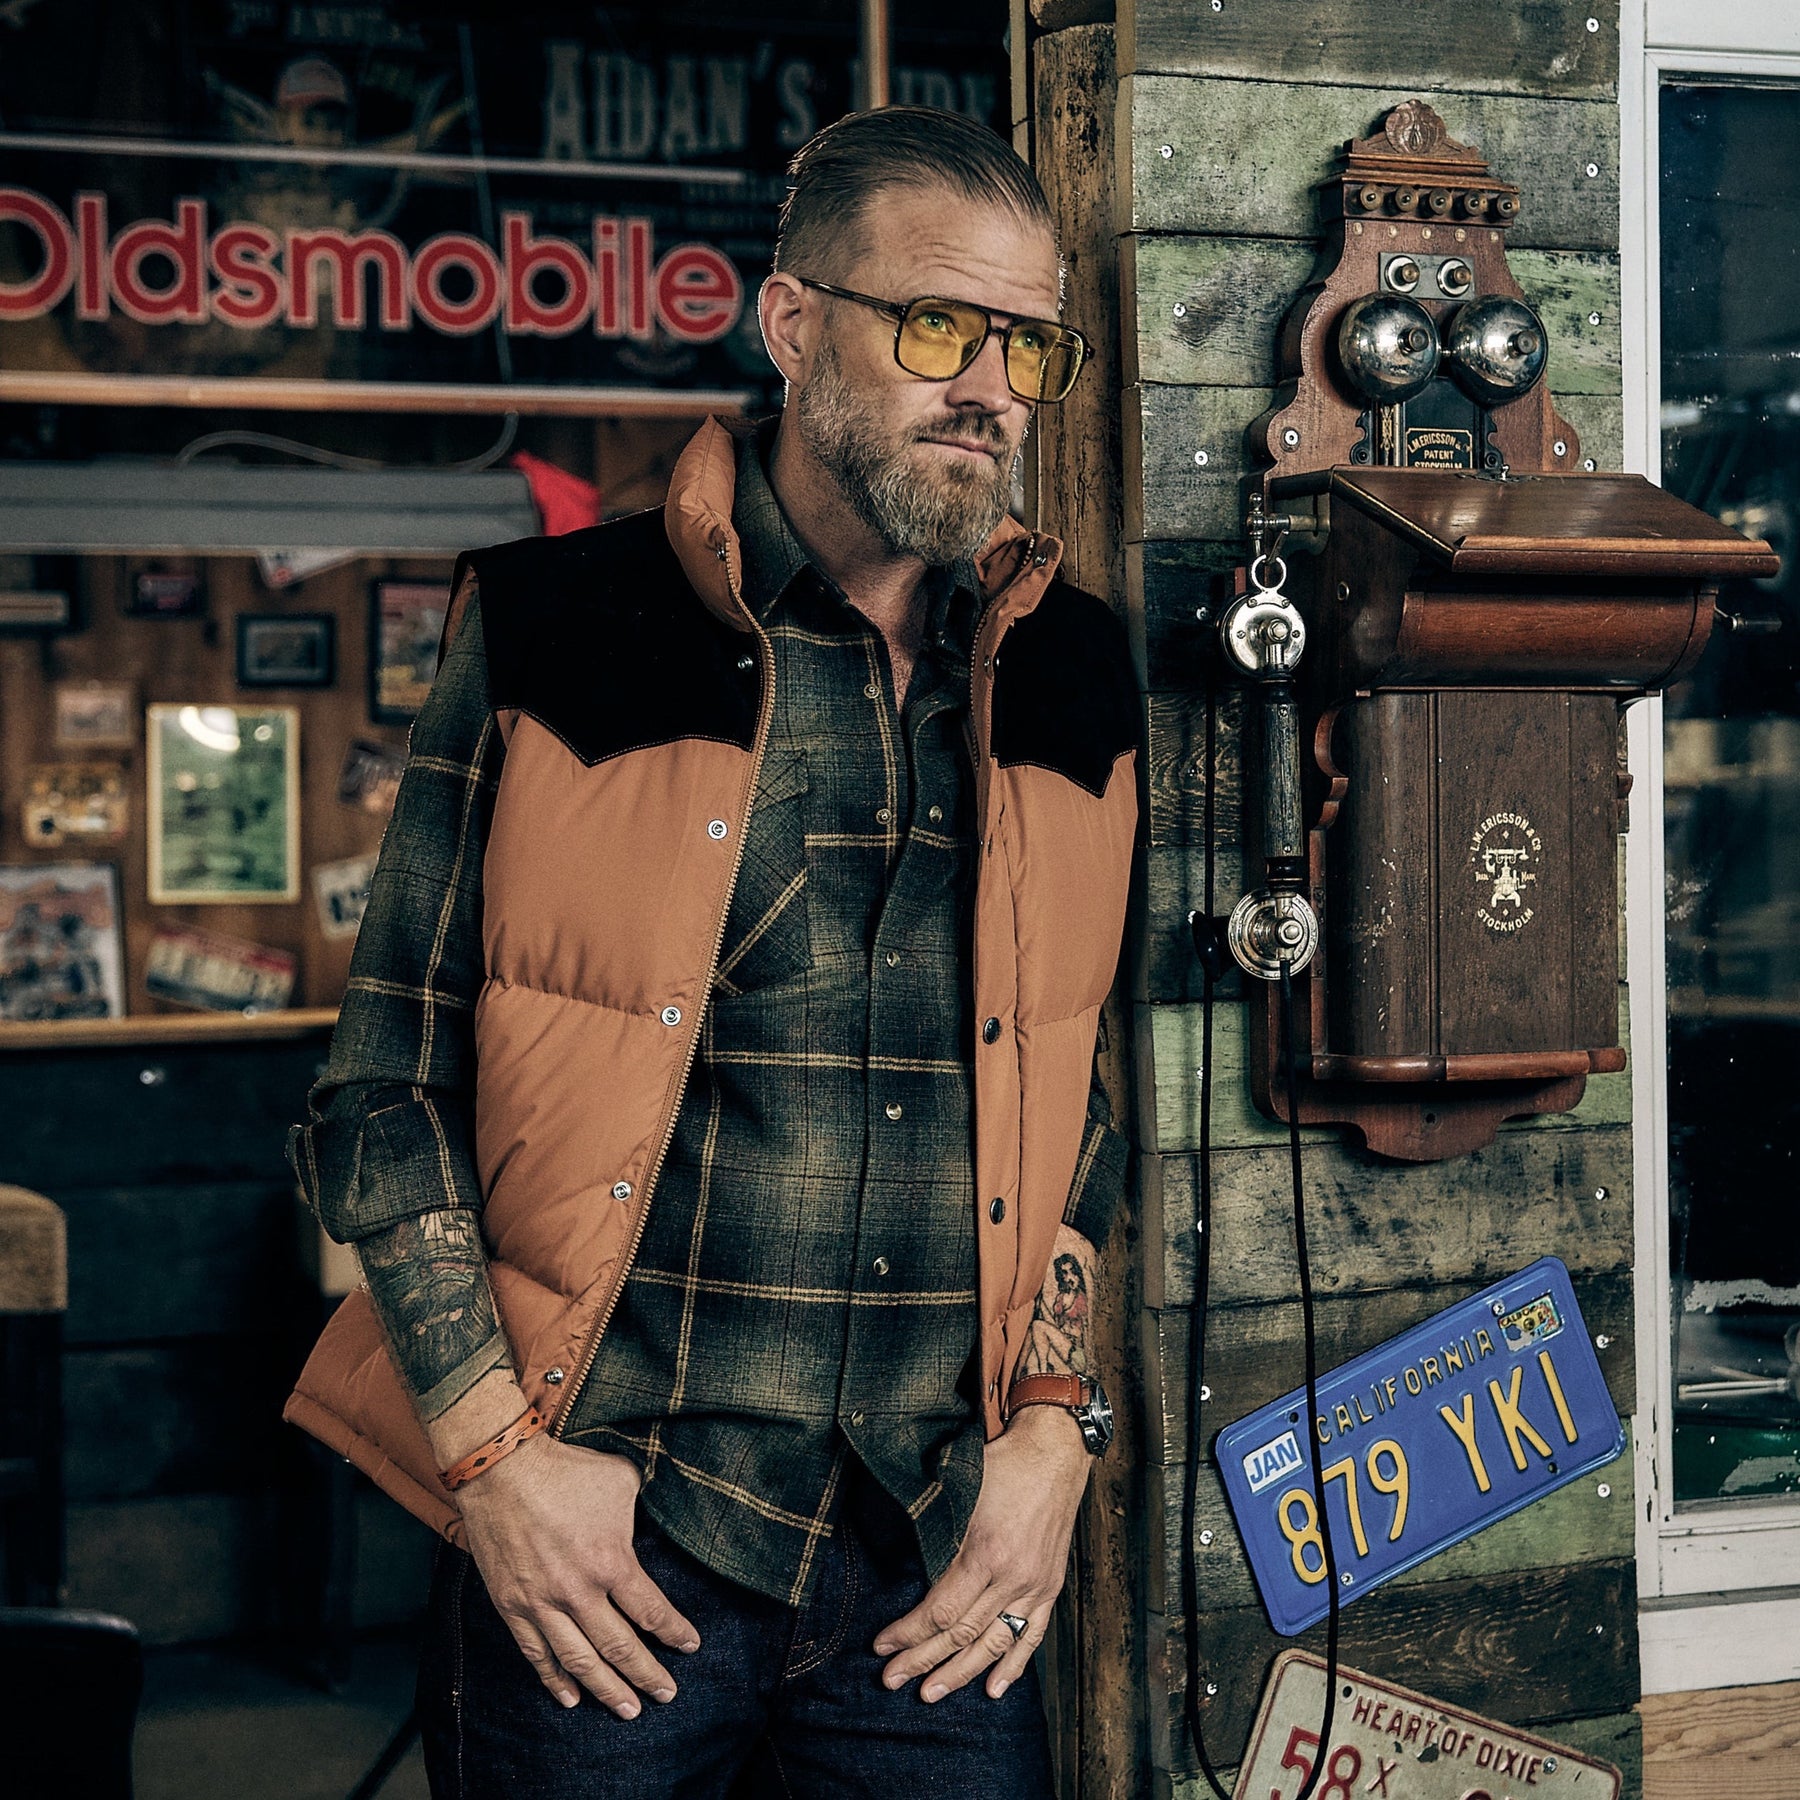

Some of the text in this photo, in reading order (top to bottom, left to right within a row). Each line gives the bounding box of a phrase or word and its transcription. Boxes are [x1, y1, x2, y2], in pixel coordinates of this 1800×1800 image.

[544, 38, 818, 161] AIDAN'S
[0, 187, 745, 344] Oldsmobile
[1424, 449, 1454, 460] PATENT
[1481, 812, 1529, 833] ERICSSON
[1526, 828, 1535, 838] &
[1477, 908, 1534, 931] STOCKHOLM
[1316, 1329, 1495, 1443] CALIFORNIA
[1250, 1438, 1298, 1485] JAN
[1352, 1696, 1544, 1785] HEART OF DIXIE
